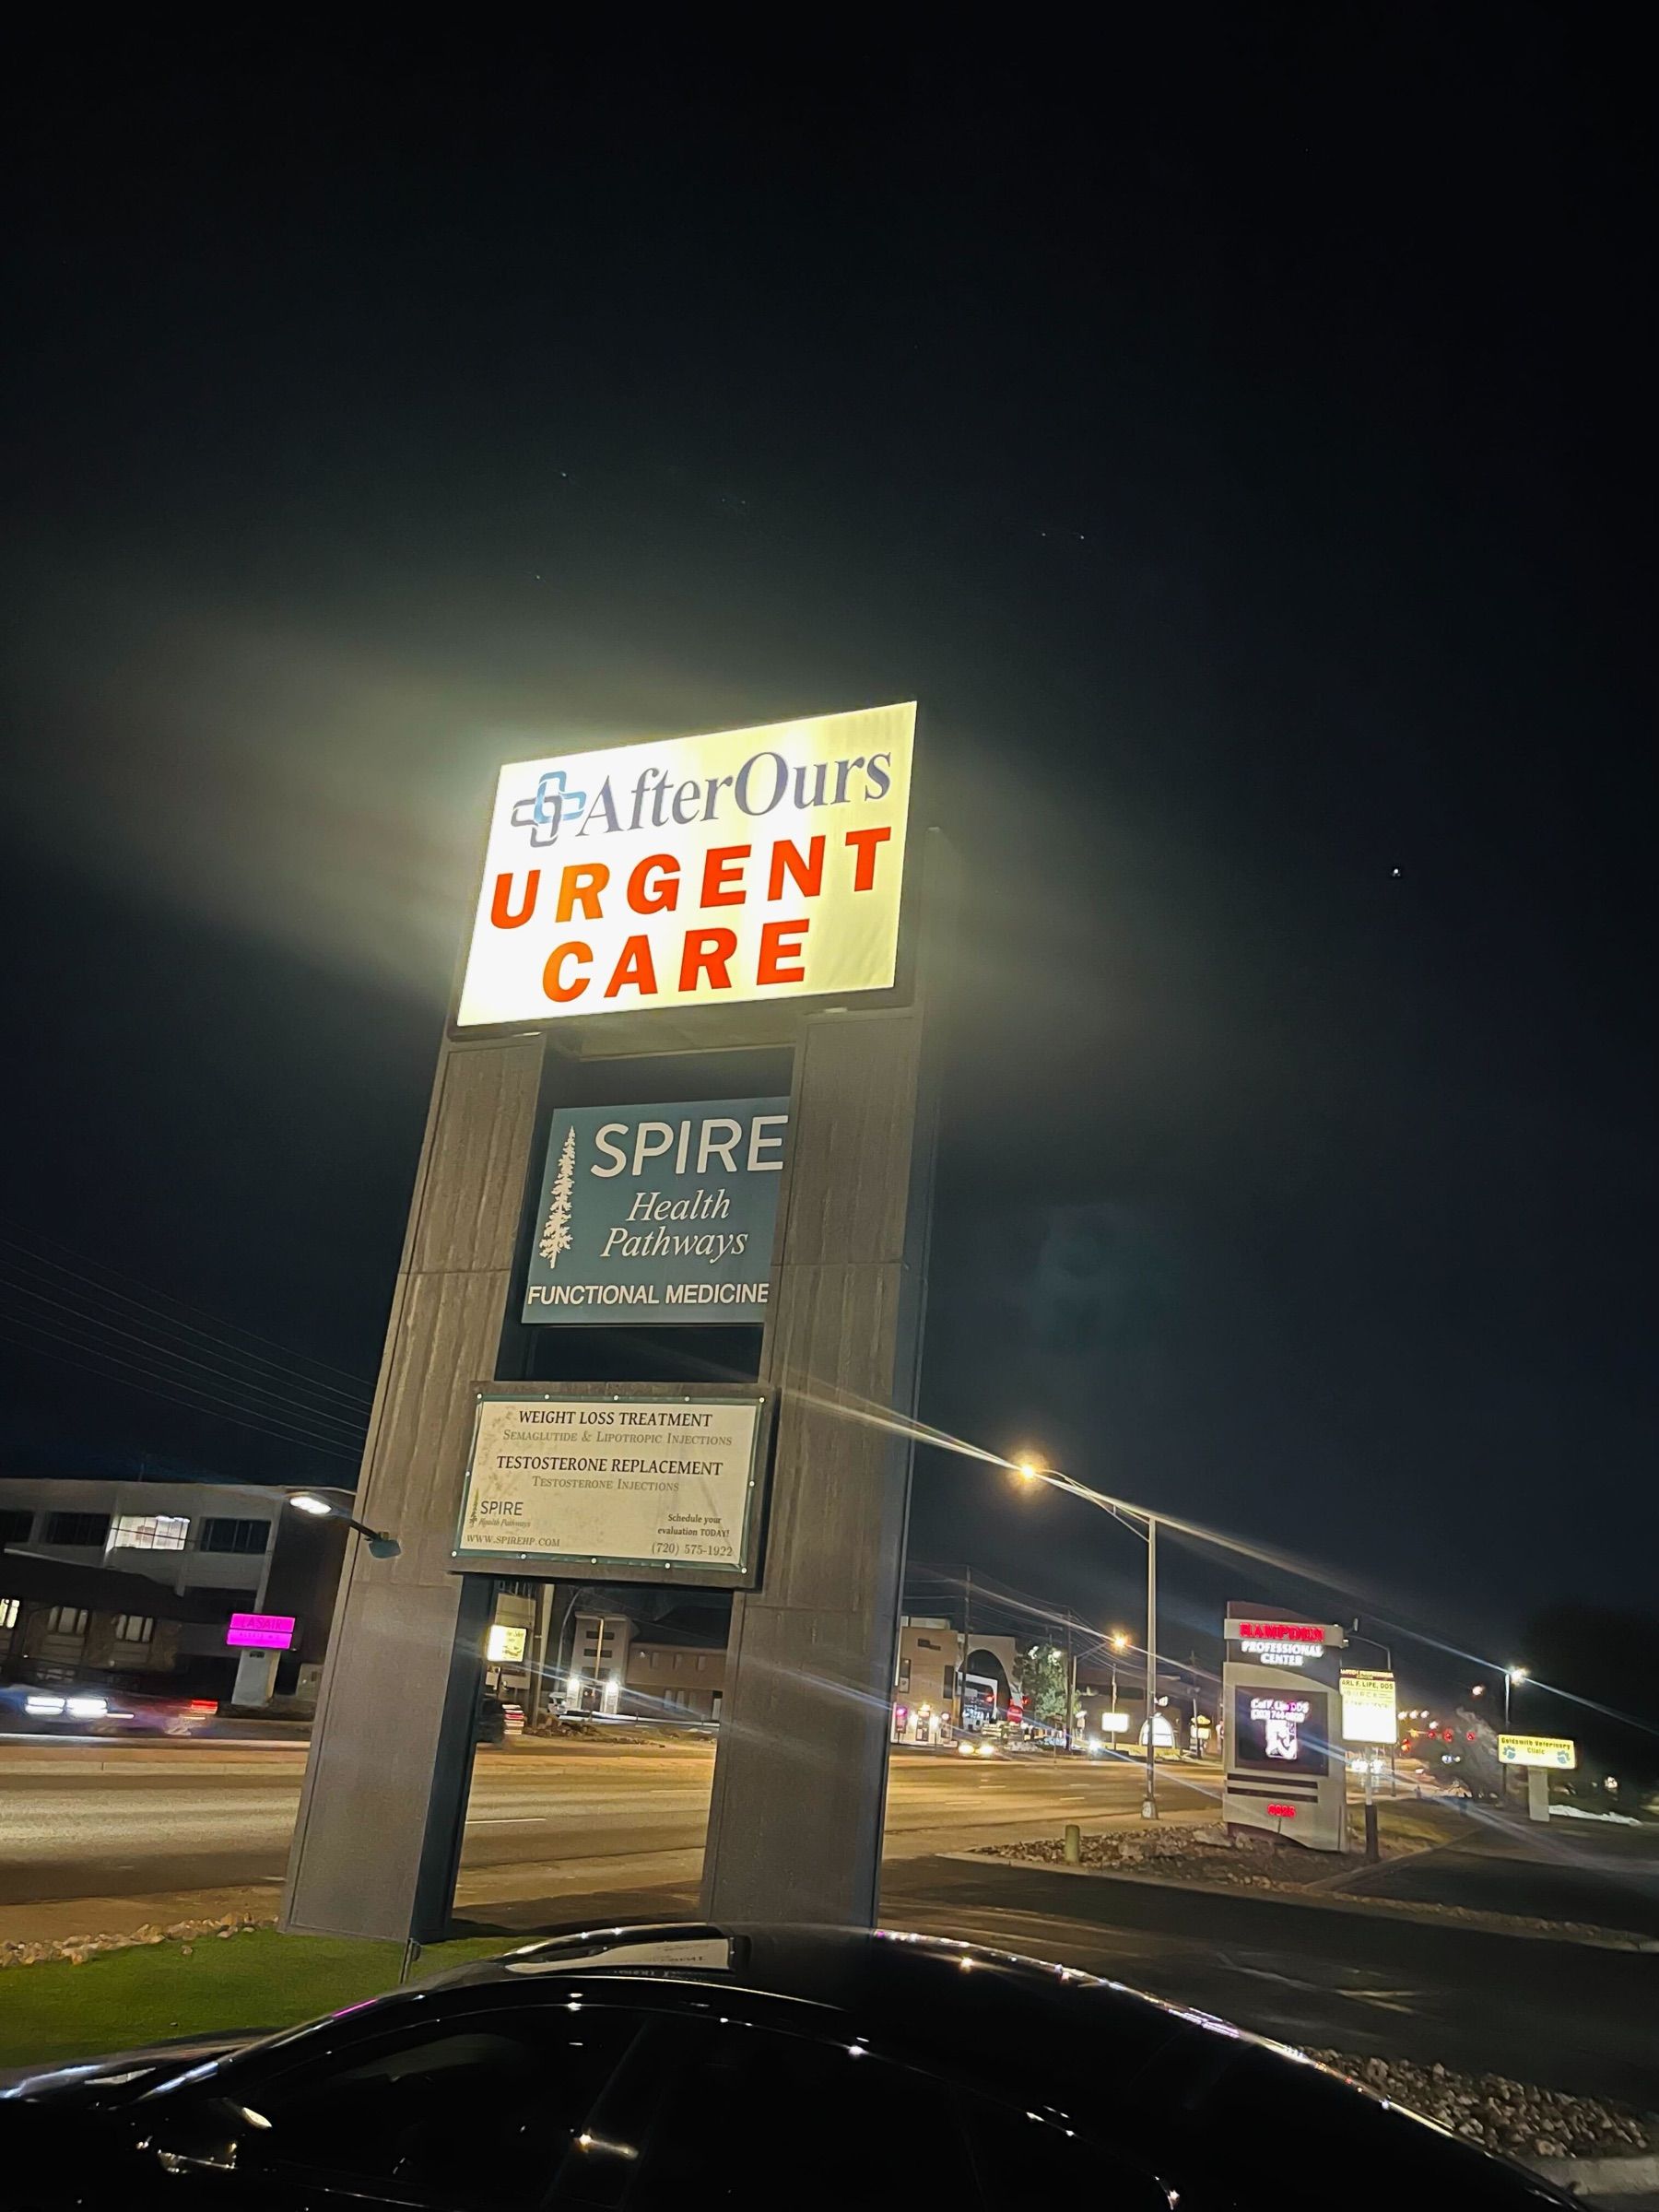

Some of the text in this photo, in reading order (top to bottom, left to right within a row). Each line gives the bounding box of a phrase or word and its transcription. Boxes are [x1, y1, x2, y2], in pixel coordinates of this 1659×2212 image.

[575, 751, 891, 837] AfterOurs
[490, 826, 891, 929] URGENT
[542, 918, 810, 1003] CARE
[590, 1115, 789, 1178] SPIRE
[626, 1188, 730, 1222] Health
[600, 1226, 748, 1264] Pathways
[527, 1283, 770, 1305] FUNCTIONAL MEDICINE
[519, 1410, 713, 1428] WEIGHT LOSS TREATMENT
[582, 1430, 593, 1442] &
[497, 1455, 724, 1476] TESTOSTERONE REPLACEMENT
[480, 1500, 524, 1516] SPIRE
[668, 1513, 722, 1525] Schedule your
[466, 1535, 560, 1547] WWW.SPIREHP.COM
[657, 1526, 730, 1537] evaluation TODAY!
[652, 1542, 733, 1557] (720) 575-1922
[1240, 1622, 1325, 1642] HAMPDEN
[1241, 1641, 1324, 1658] PROFESSIONAL
[1260, 1653, 1304, 1666] CENTER
